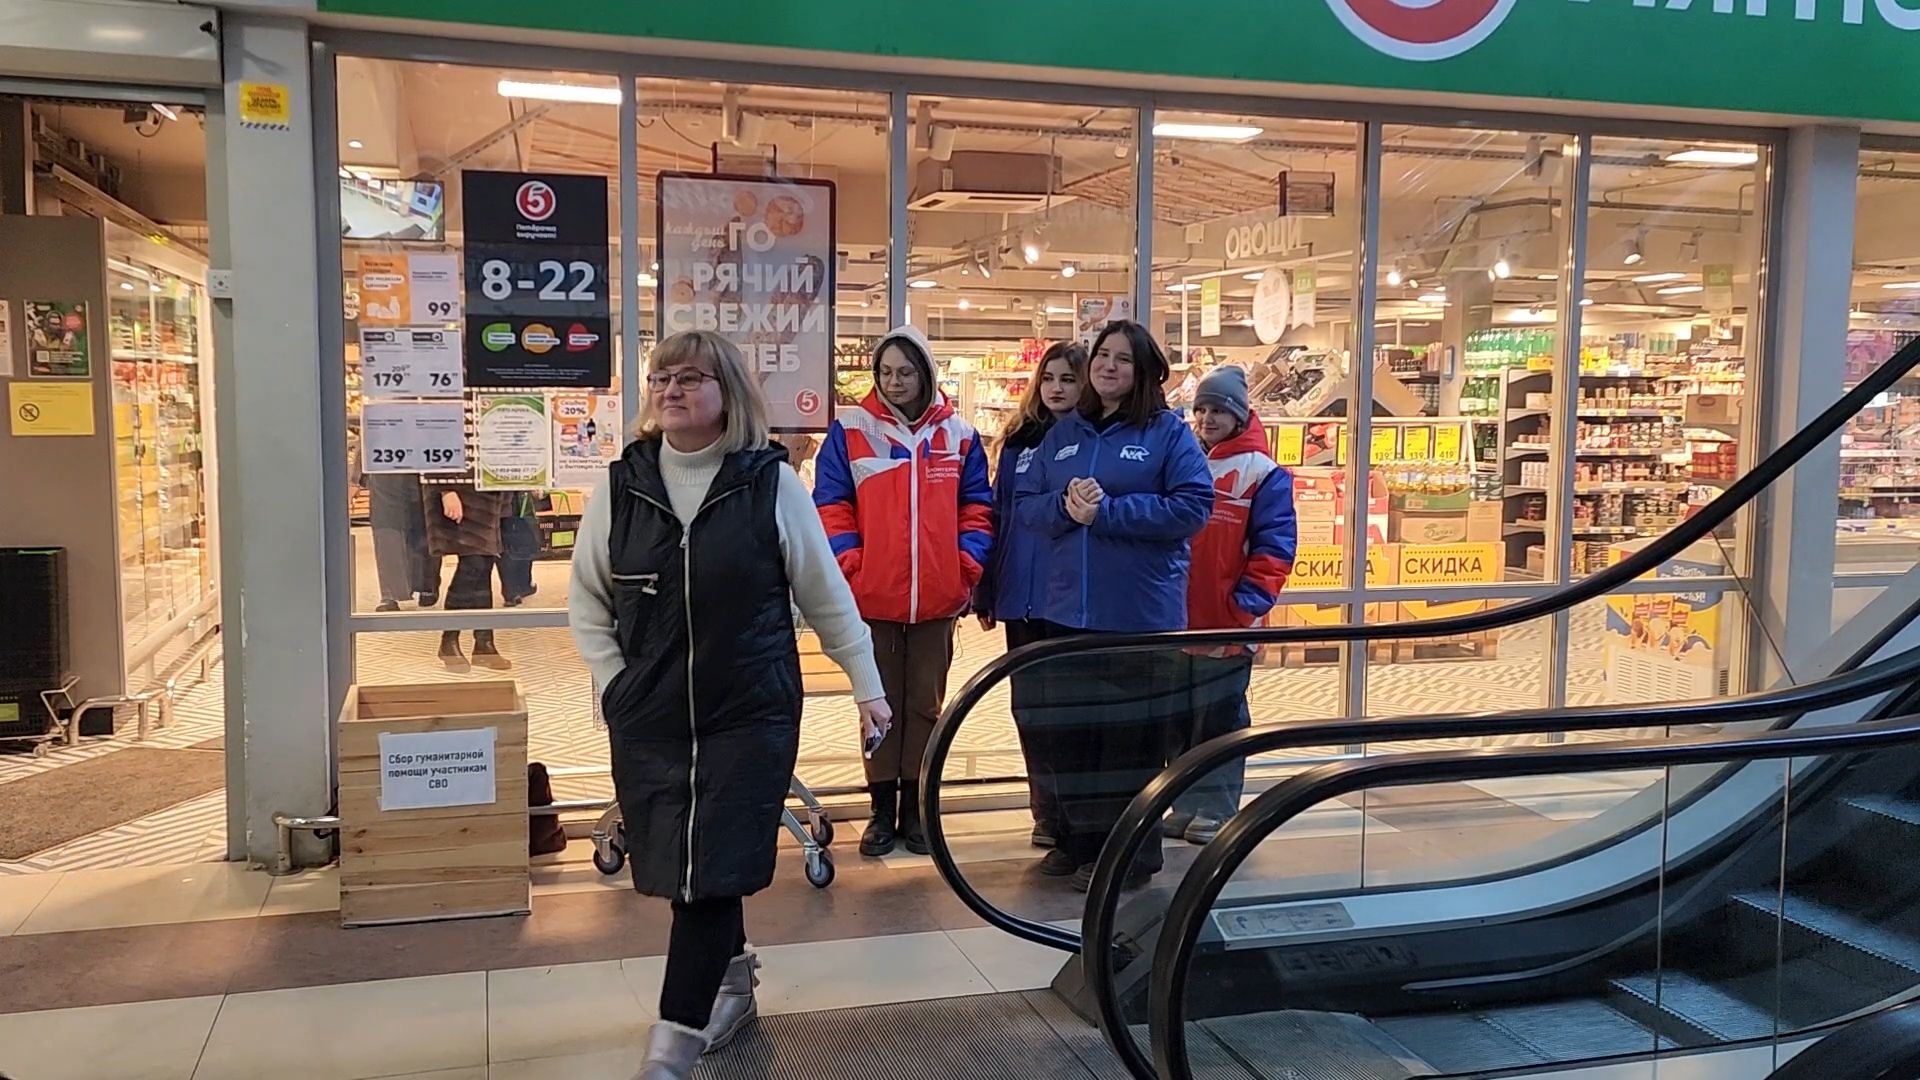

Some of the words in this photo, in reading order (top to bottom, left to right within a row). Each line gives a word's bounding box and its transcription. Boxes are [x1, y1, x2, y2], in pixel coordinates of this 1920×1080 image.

[729, 222, 776, 252] ГО
[1226, 217, 1302, 259] ОВОЩИ
[692, 256, 814, 293] РЯЧИЙ
[428, 302, 451, 315] 99
[668, 299, 825, 333] СВЕЖИЙ
[740, 344, 800, 372] ЛЕБ
[373, 373, 403, 386] 179
[429, 373, 452, 386] 76
[373, 449, 406, 462] 239
[423, 449, 453, 462] 159
[1405, 557, 1483, 576] СКИДКА
[388, 753, 413, 765] Сбор
[415, 749, 484, 764] гуманитарной
[388, 767, 428, 778] помощи
[430, 764, 487, 777] участникам
[428, 778, 448, 789] СВО
